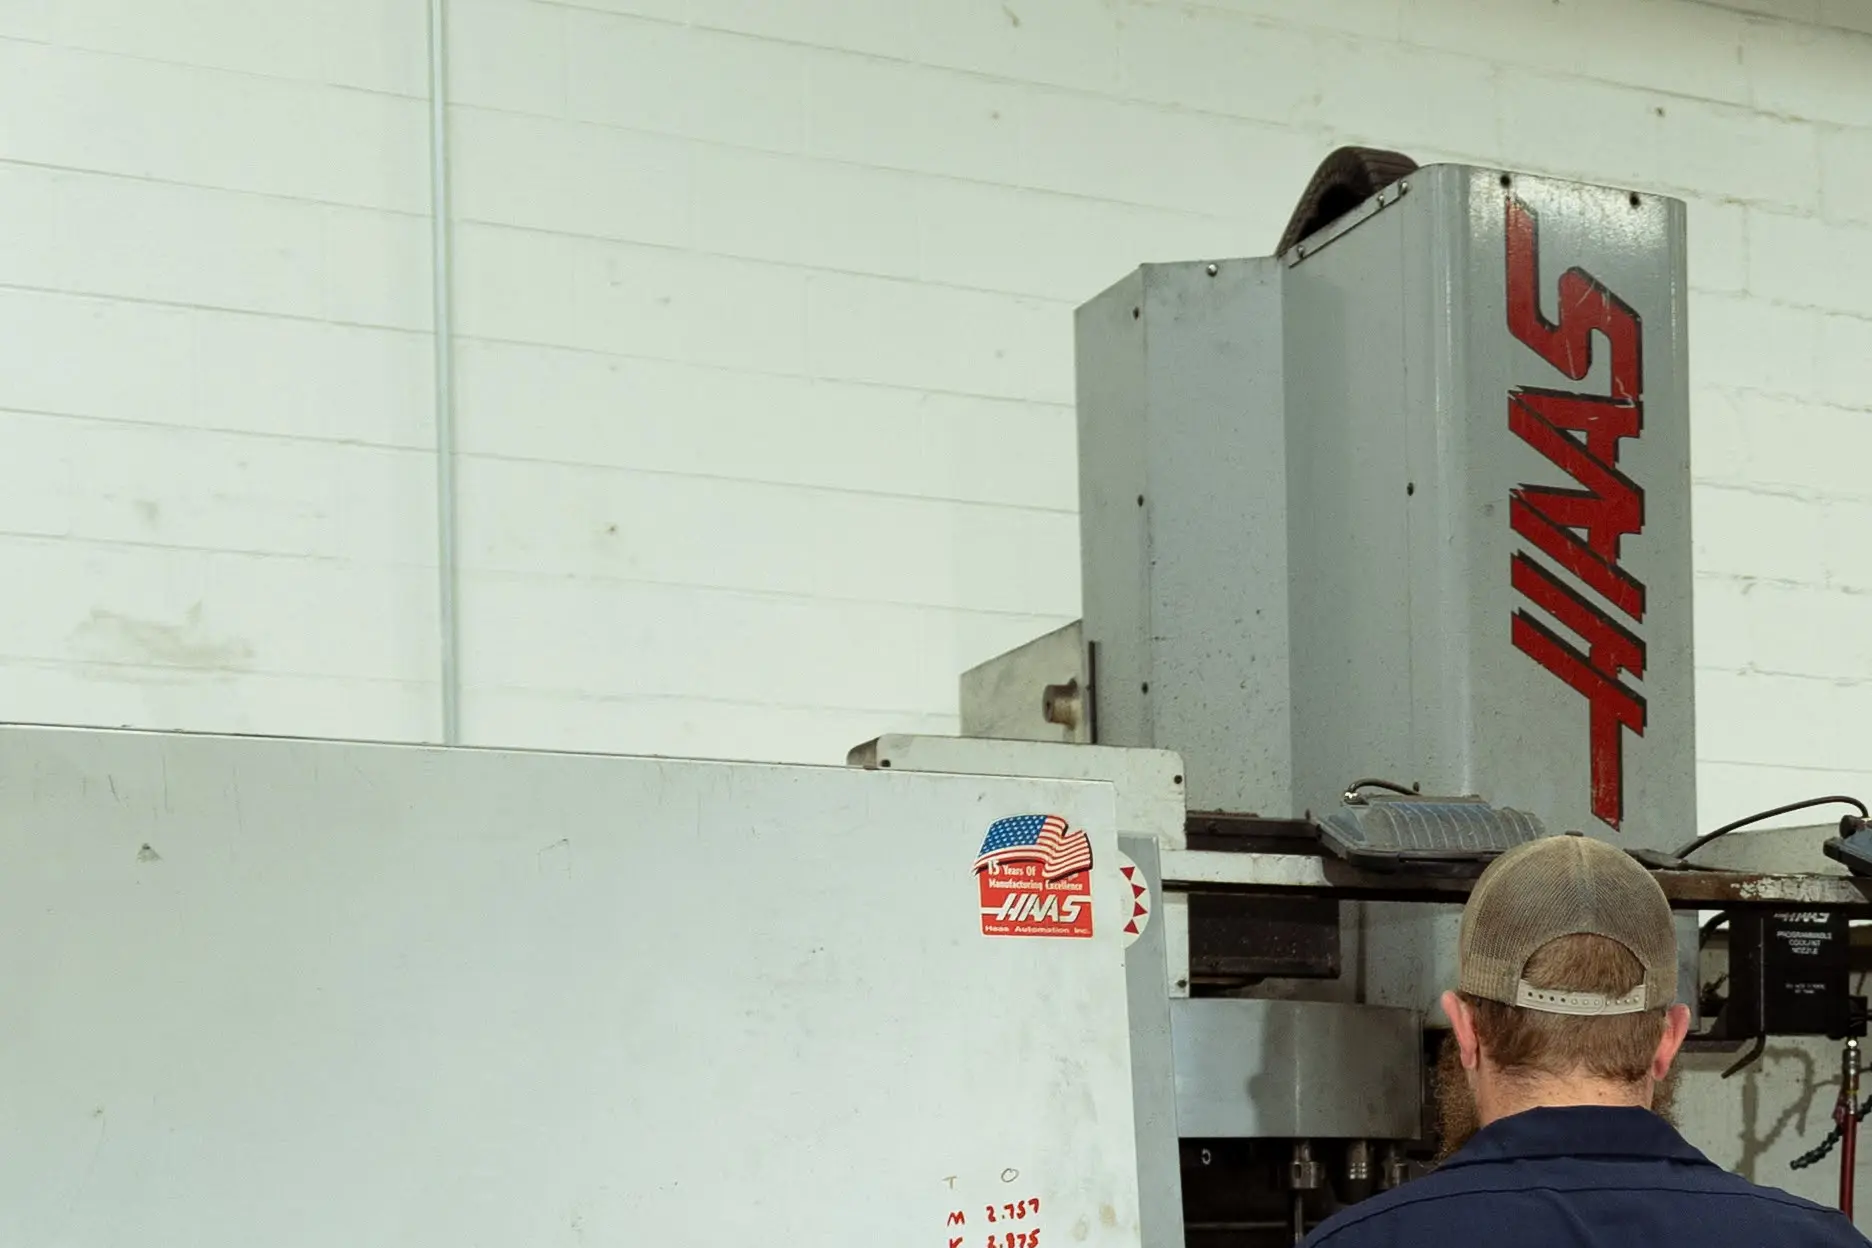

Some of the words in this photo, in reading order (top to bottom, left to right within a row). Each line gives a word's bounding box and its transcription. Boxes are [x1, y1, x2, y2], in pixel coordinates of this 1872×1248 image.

[1505, 198, 1647, 831] HAAS
[988, 860, 1000, 875] 15
[1002, 864, 1024, 876] Years
[1026, 865, 1037, 876] Of
[989, 878, 1043, 891] Manufacturing
[1045, 880, 1083, 890] Excellence
[984, 893, 1089, 922] HAAS
[1774, 912, 1831, 923] HAAS
[1015, 925, 1069, 934] Automation
[946, 1210, 966, 1225] M
[986, 1197, 1041, 1225] 2.757
